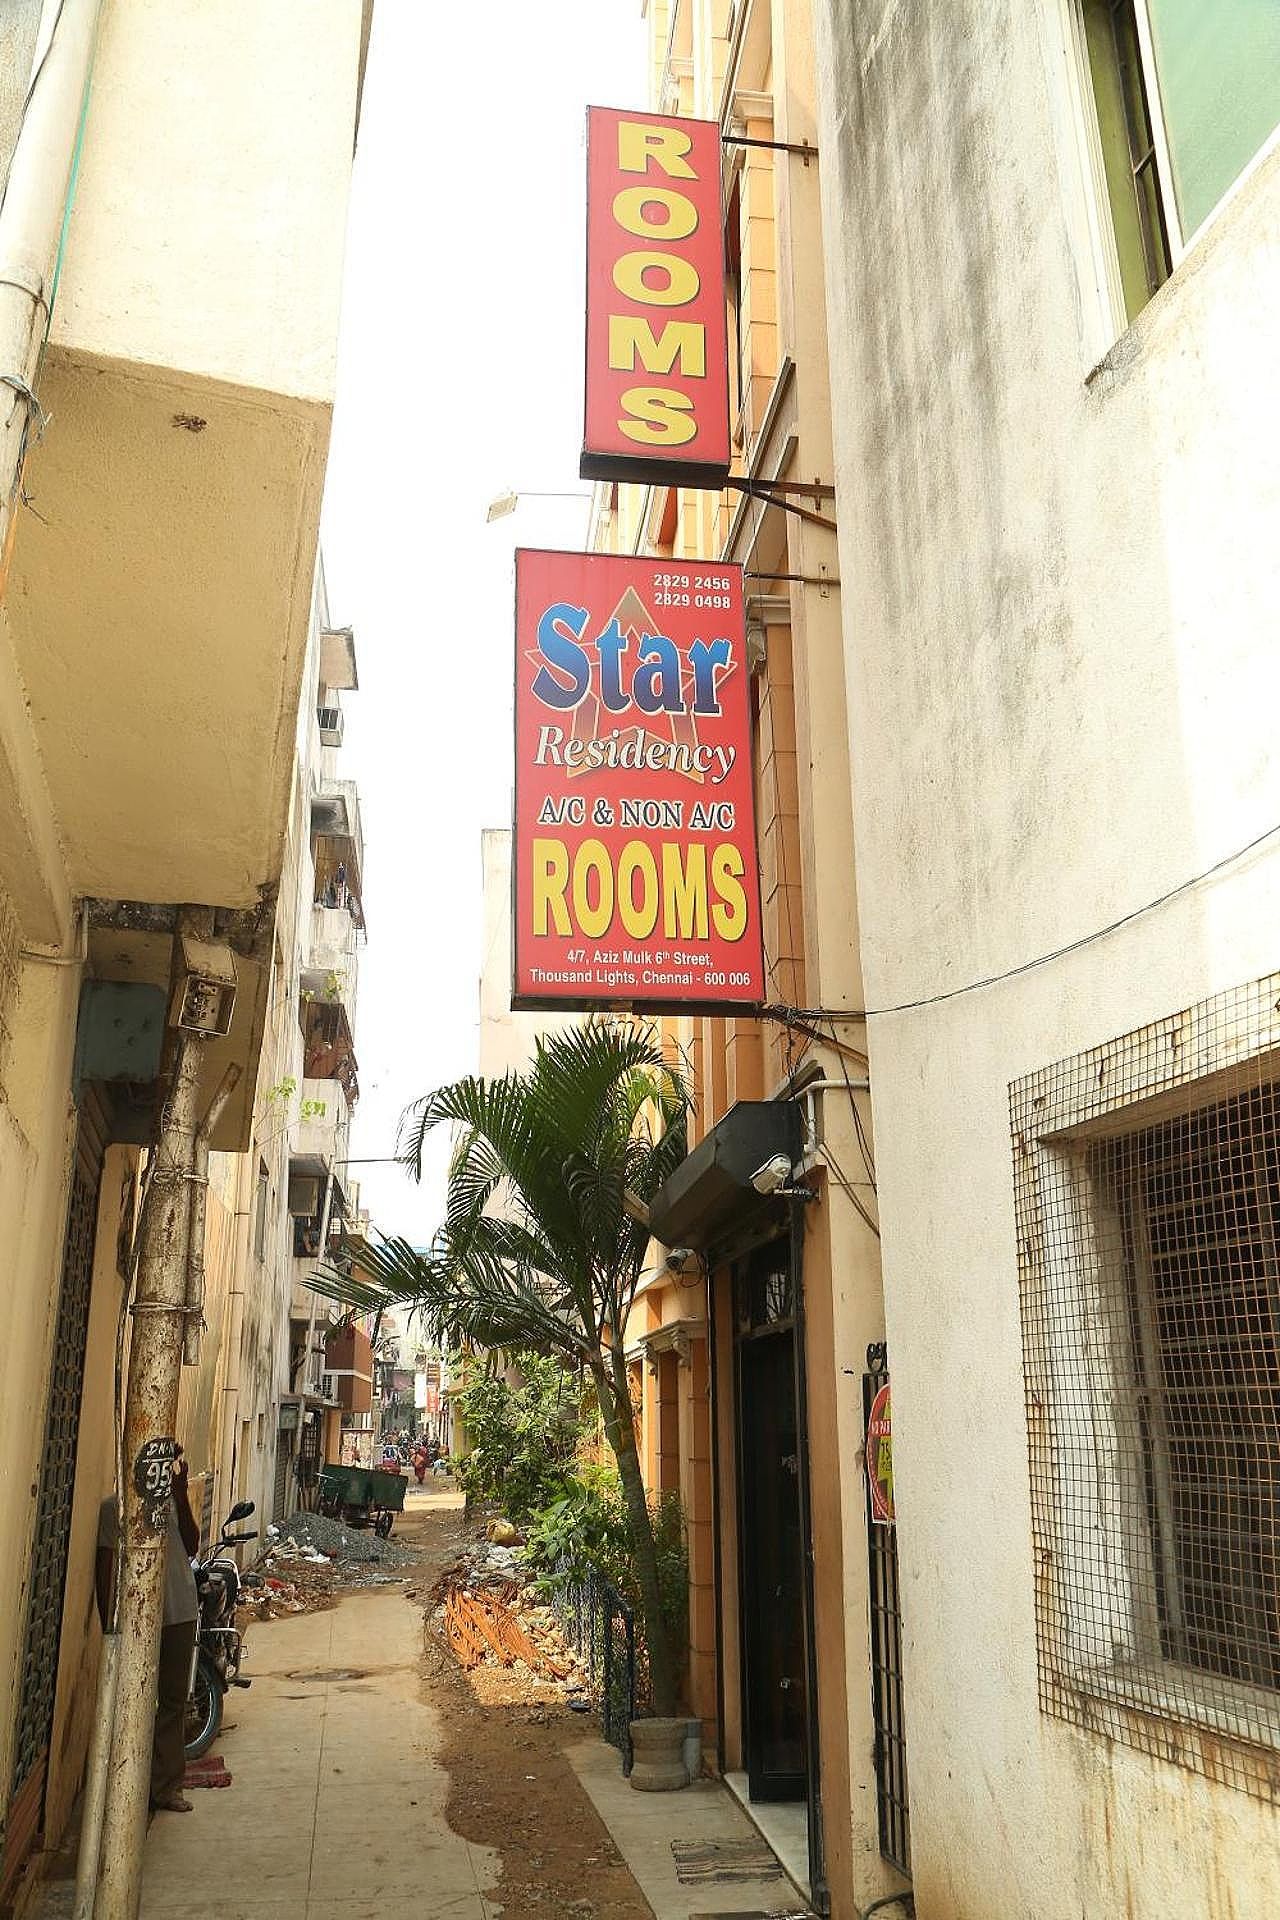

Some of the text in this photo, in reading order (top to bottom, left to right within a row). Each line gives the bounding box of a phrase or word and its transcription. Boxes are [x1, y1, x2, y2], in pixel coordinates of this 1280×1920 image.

[608, 119, 706, 447] ROOMS
[653, 574, 731, 591] 2829 2456
[654, 592, 731, 609] 2829 0498
[530, 601, 733, 717] Star
[533, 726, 736, 785] Residency
[538, 796, 735, 832] A/C & NON A/C
[532, 837, 748, 943] ROOMS
[567, 949, 589, 966] 4/7,
[593, 950, 620, 965] Aziz
[622, 951, 652, 966] Mulk
[673, 952, 714, 968] Street,
[530, 968, 592, 983] Thousand
[597, 970, 639, 986] Lights,
[642, 971, 693, 985] Chennai
[704, 972, 725, 985] 600
[729, 973, 751, 986] 006
